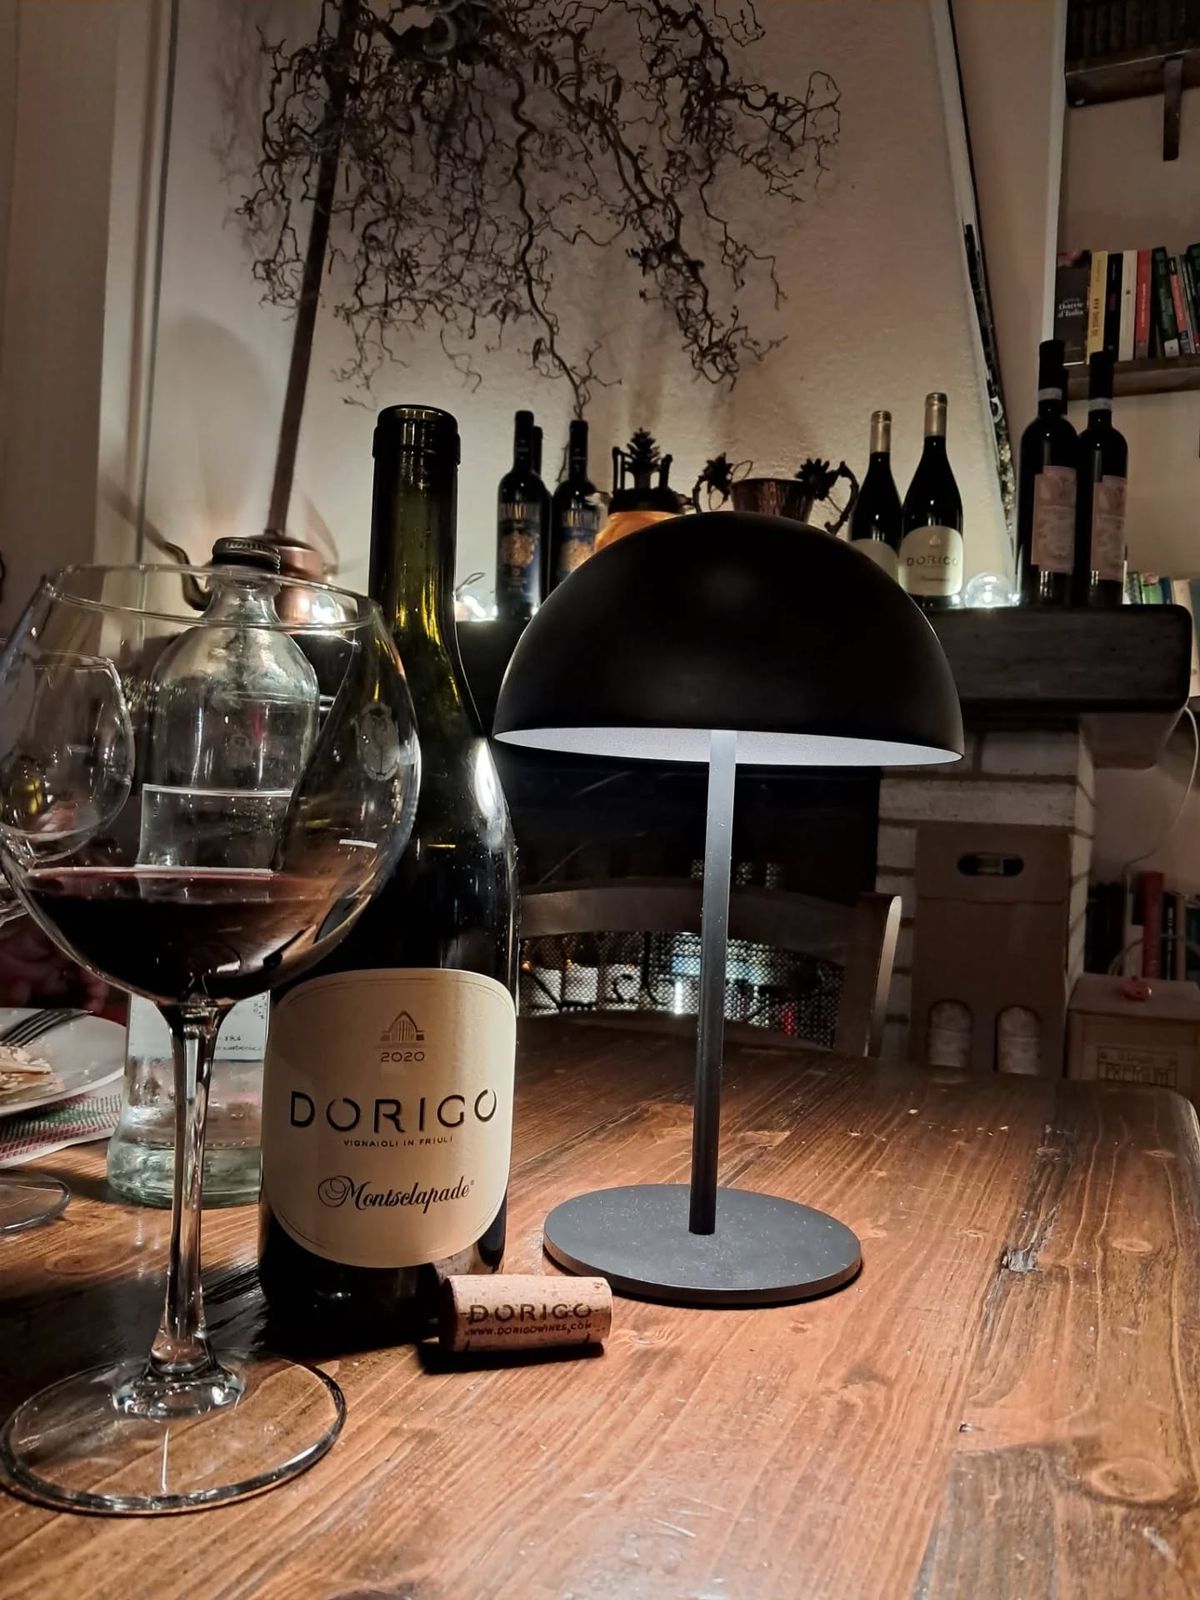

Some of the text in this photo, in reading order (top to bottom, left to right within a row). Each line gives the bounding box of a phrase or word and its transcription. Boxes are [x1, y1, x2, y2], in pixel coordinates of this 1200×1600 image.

[381, 1051, 425, 1063] 2020
[289, 1088, 498, 1134] DORIGO
[343, 1135, 454, 1148] VIGNAIOLI IN FRIULI
[469, 1302, 593, 1325] DORIGO
